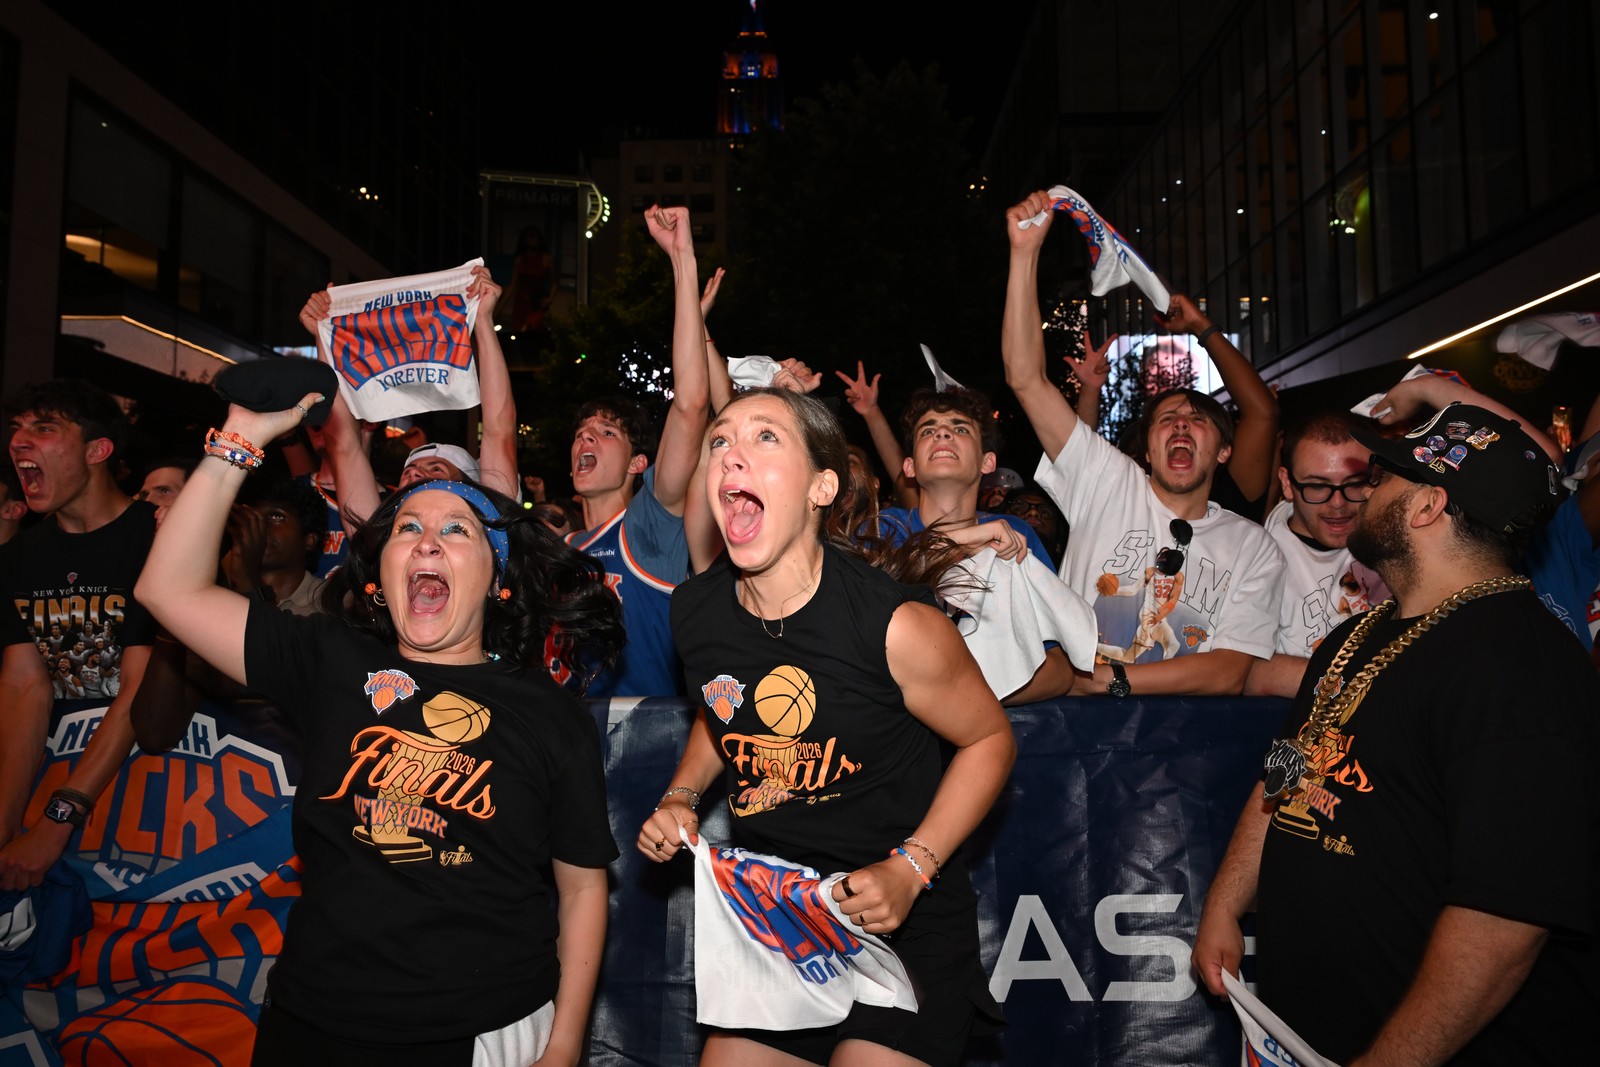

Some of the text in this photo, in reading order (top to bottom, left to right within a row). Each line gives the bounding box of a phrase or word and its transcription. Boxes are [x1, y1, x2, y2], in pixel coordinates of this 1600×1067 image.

[495, 188, 572, 207] PRIMARK
[364, 290, 433, 313] NEW YORK
[331, 294, 472, 391] KNICKS
[33, 589, 54, 599] NEW
[1155, 585, 1171, 598] 32
[14, 594, 126, 632] FINALS
[366, 672, 413, 695] KNICKS
[704, 680, 743, 701] KNICKS
[57, 716, 102, 753] NE
[446, 750, 476, 775] 2026
[796, 742, 823, 760] 2026
[1264, 739, 1307, 780] KNICKS
[318, 725, 496, 819] Finals
[1302, 782, 1342, 822] YORK
[353, 793, 448, 839] NEW YORK
